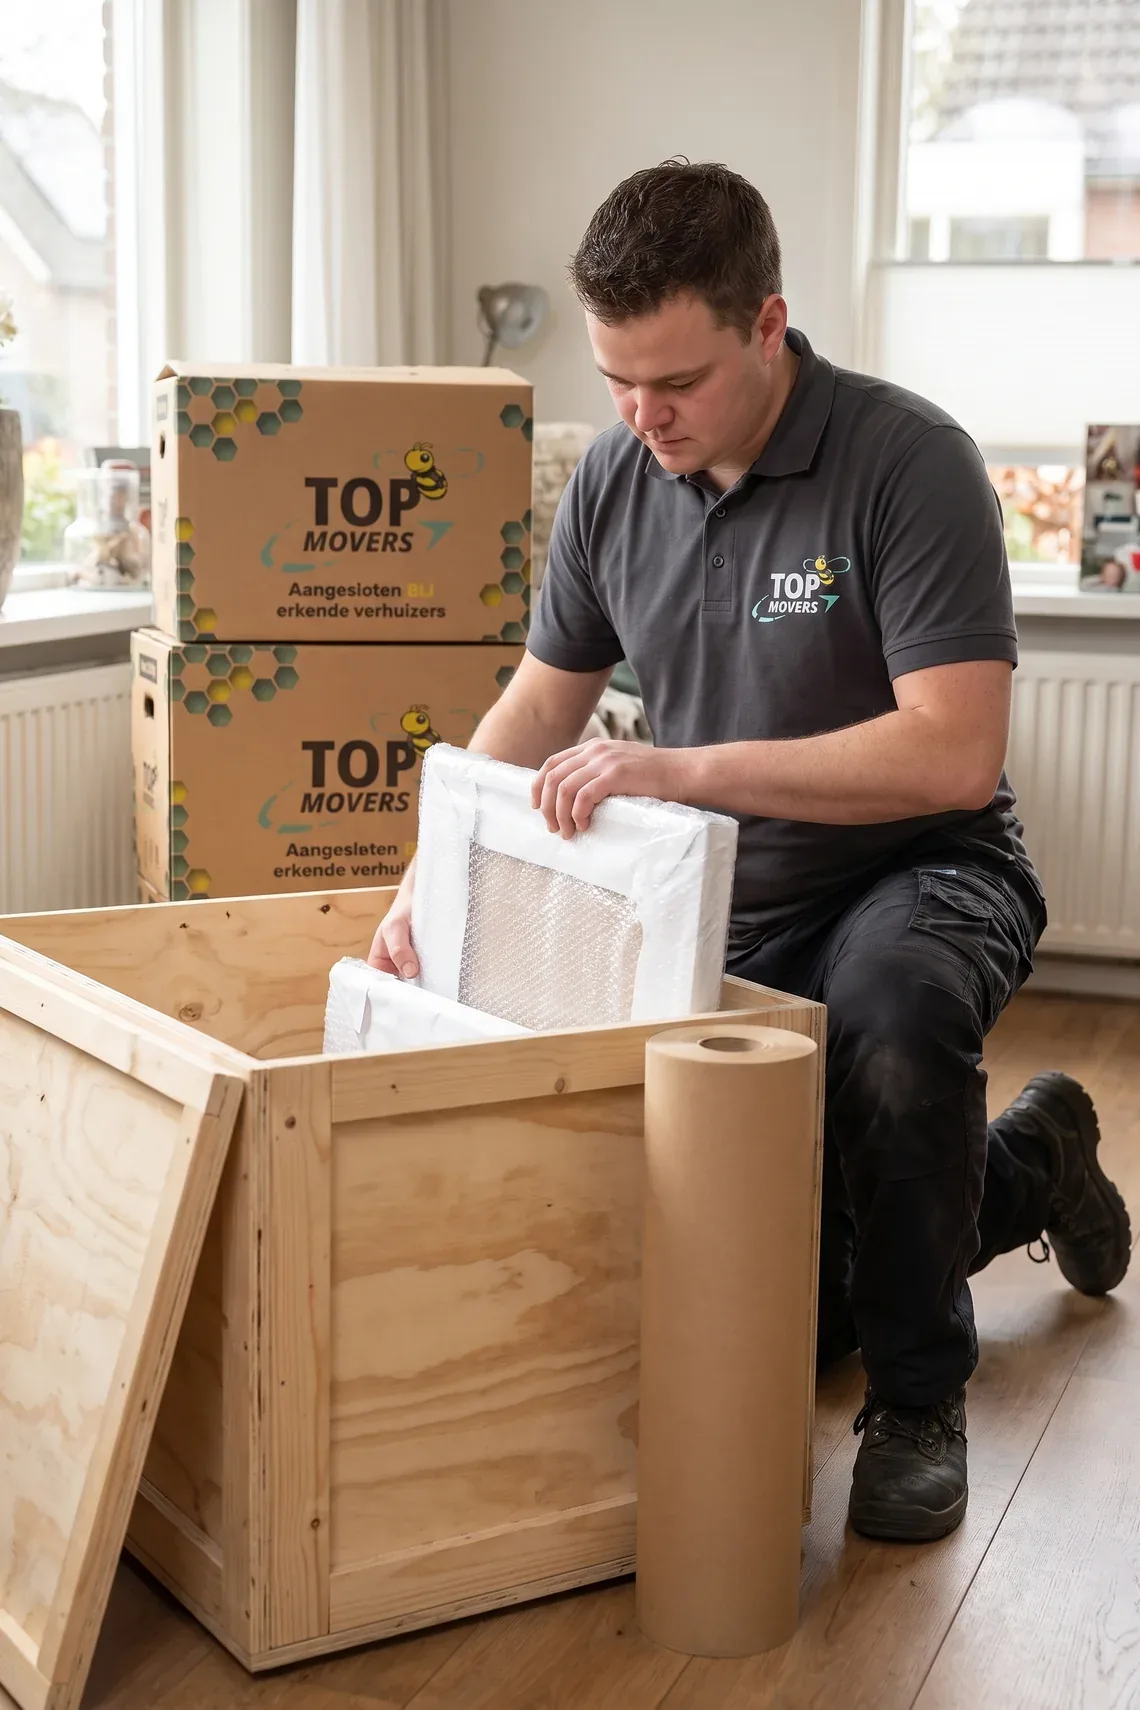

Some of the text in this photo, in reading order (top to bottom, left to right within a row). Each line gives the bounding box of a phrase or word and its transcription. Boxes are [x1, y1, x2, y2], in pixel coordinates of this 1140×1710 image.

[304, 477, 421, 527] TOP
[303, 530, 414, 553] MOVERS
[770, 572, 820, 599] TOP
[276, 603, 446, 618] erkende verhuizers
[768, 600, 818, 614] MOVERS
[302, 740, 416, 788] TOP
[300, 791, 410, 813] MOVERS
[273, 861, 405, 878] erkende verhui
